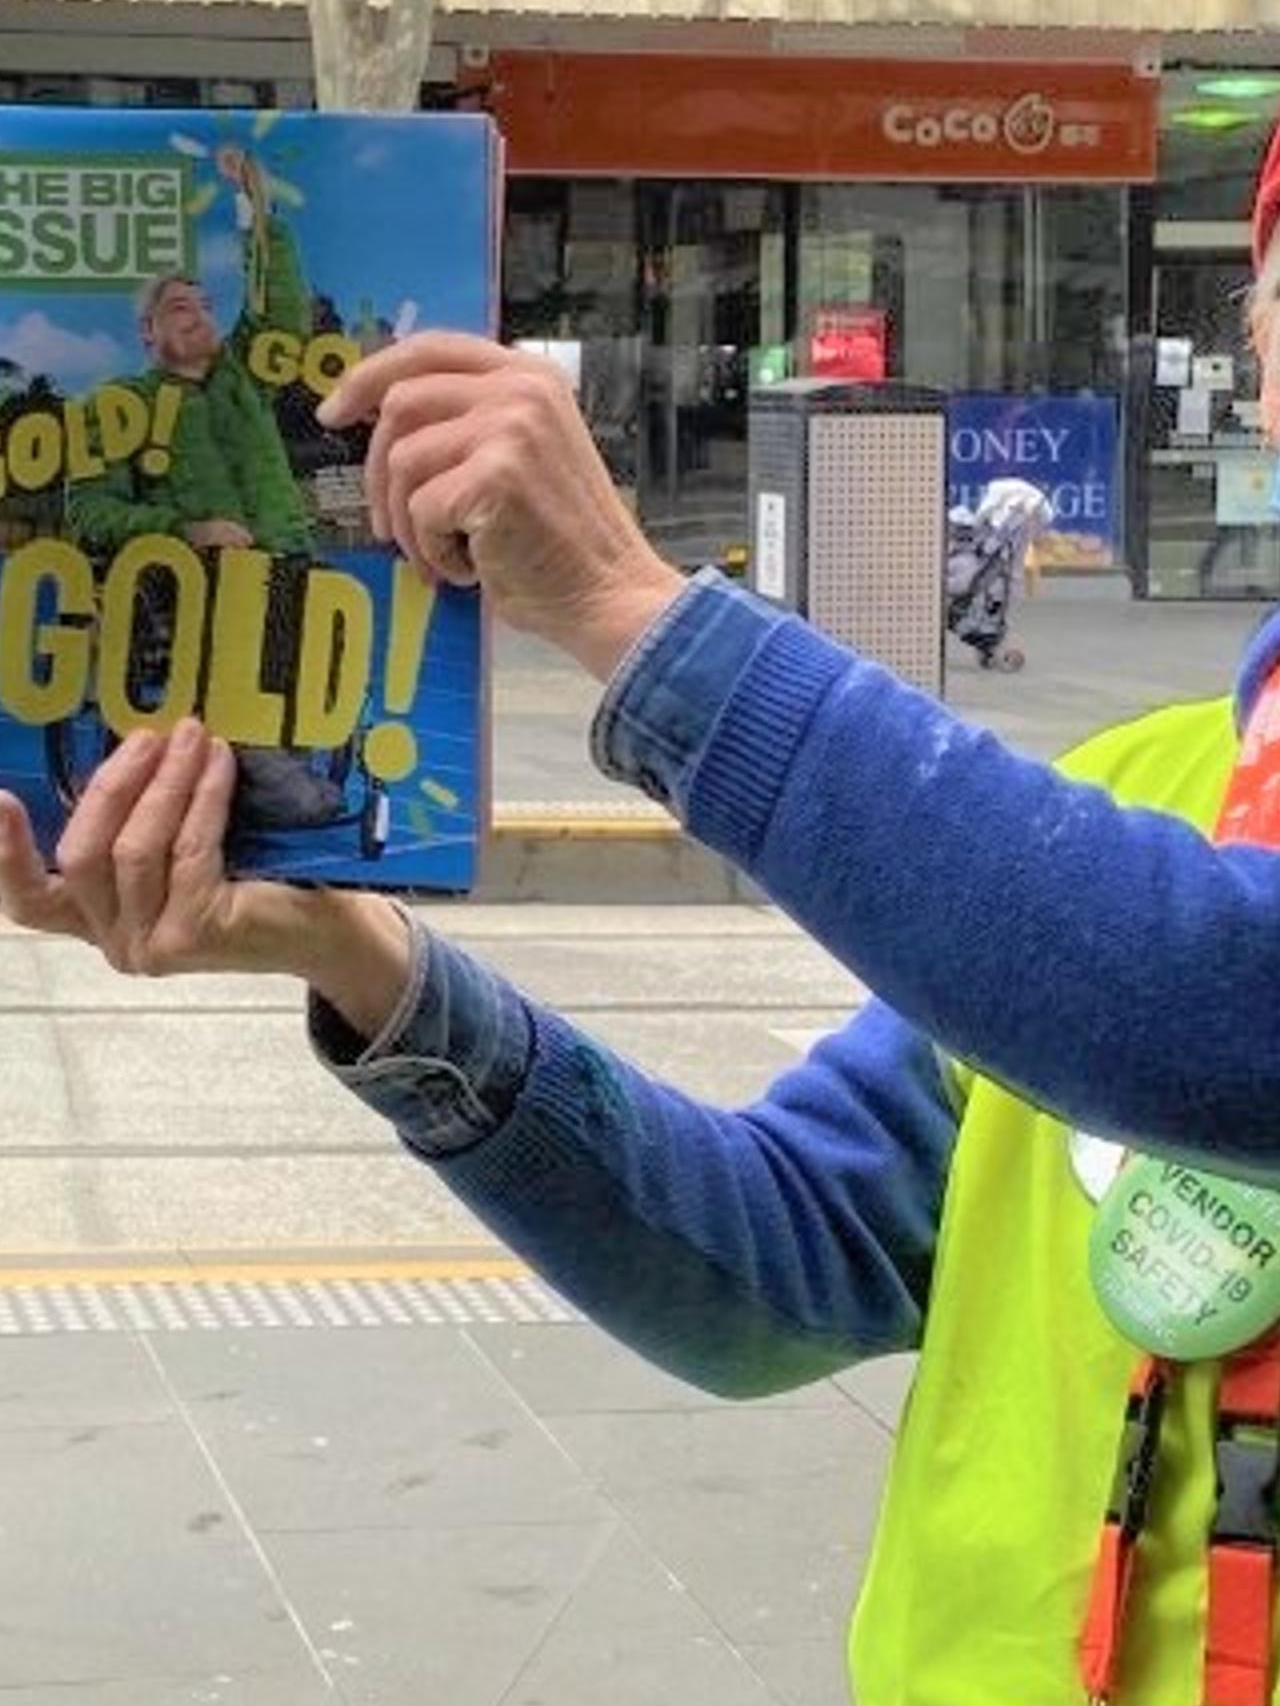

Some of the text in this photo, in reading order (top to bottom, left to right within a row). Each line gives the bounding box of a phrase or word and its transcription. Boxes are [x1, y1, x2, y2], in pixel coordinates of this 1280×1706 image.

[80, 172, 178, 208] BIG
[950, 427, 1070, 464] ONEY
[1128, 1190, 1253, 1303] COVID-19
[1157, 1162, 1277, 1269] VENDOR
[1111, 1228, 1218, 1326] SAFETY
